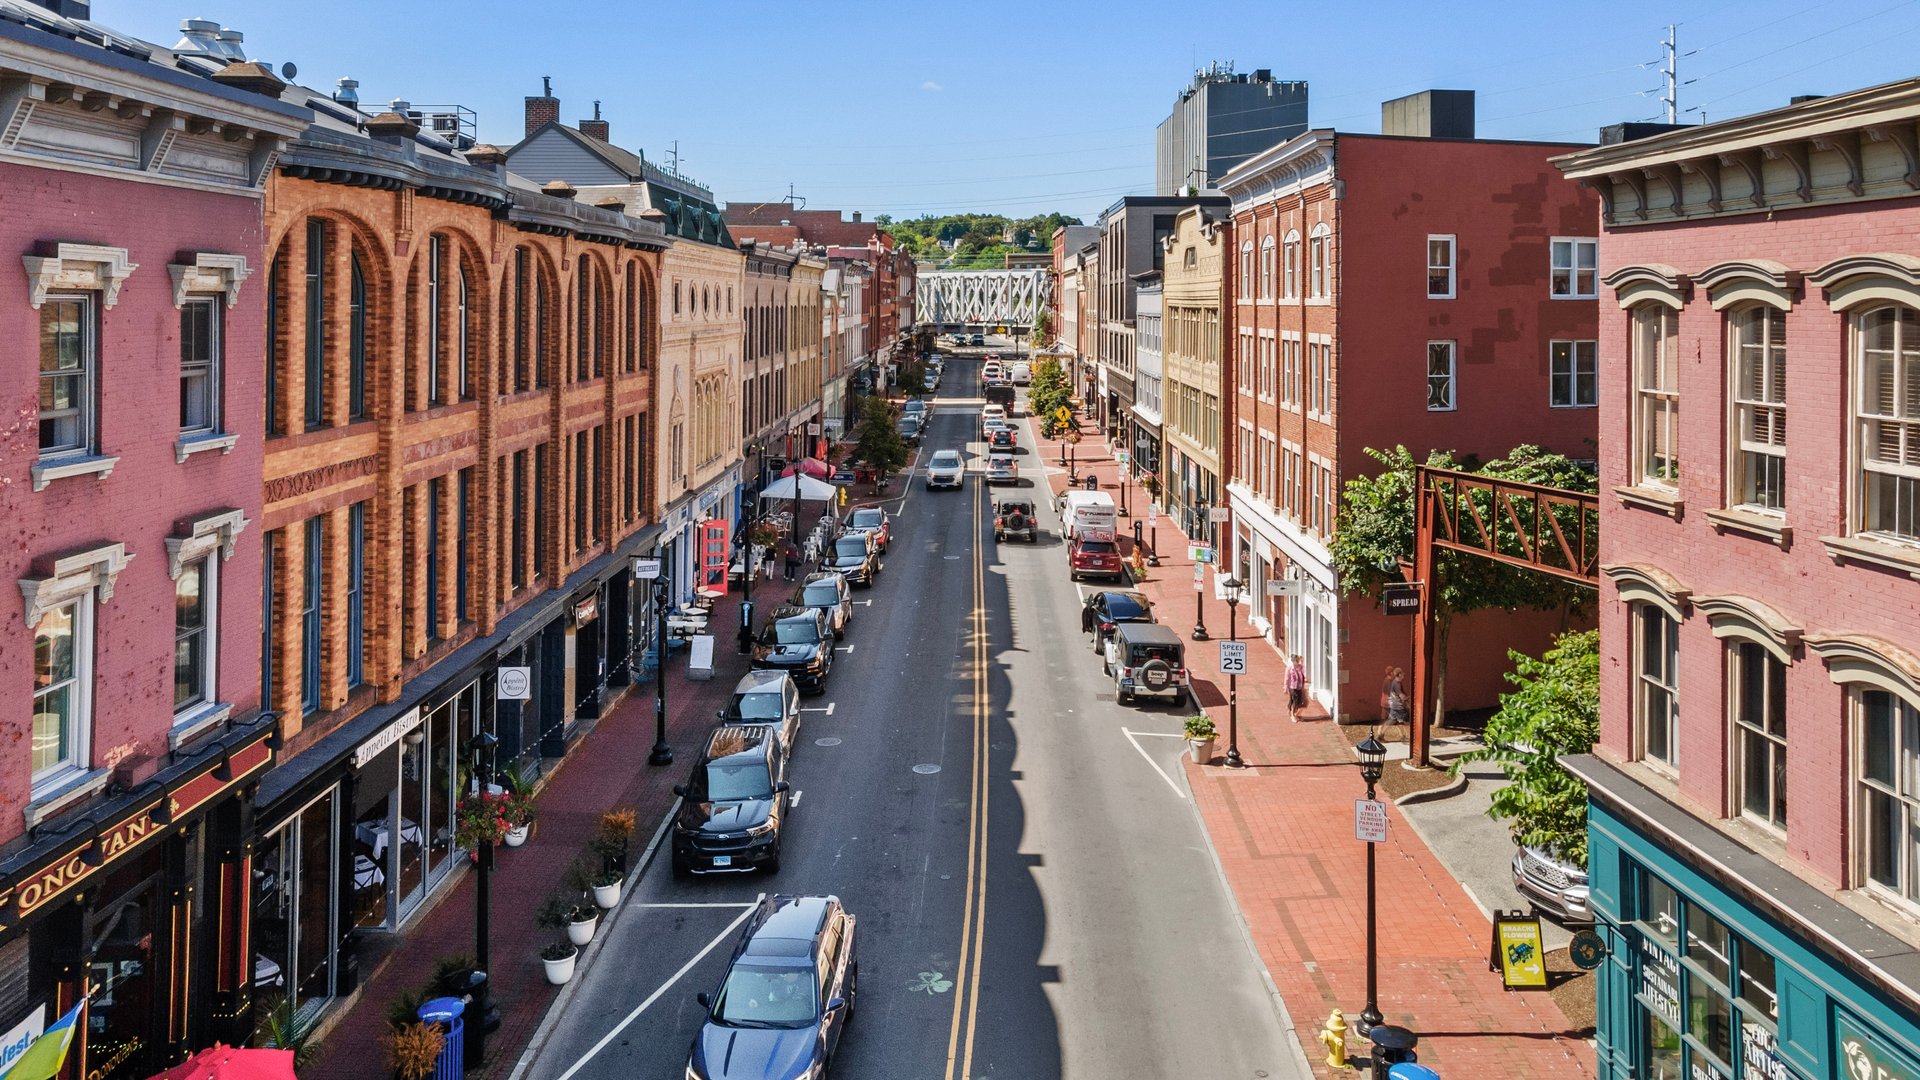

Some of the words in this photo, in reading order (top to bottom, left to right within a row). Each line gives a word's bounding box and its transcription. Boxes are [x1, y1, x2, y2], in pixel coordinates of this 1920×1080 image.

[1392, 598, 1419, 607] SPREAD
[1223, 657, 1244, 671] 25
[393, 712, 418, 739] Bistro
